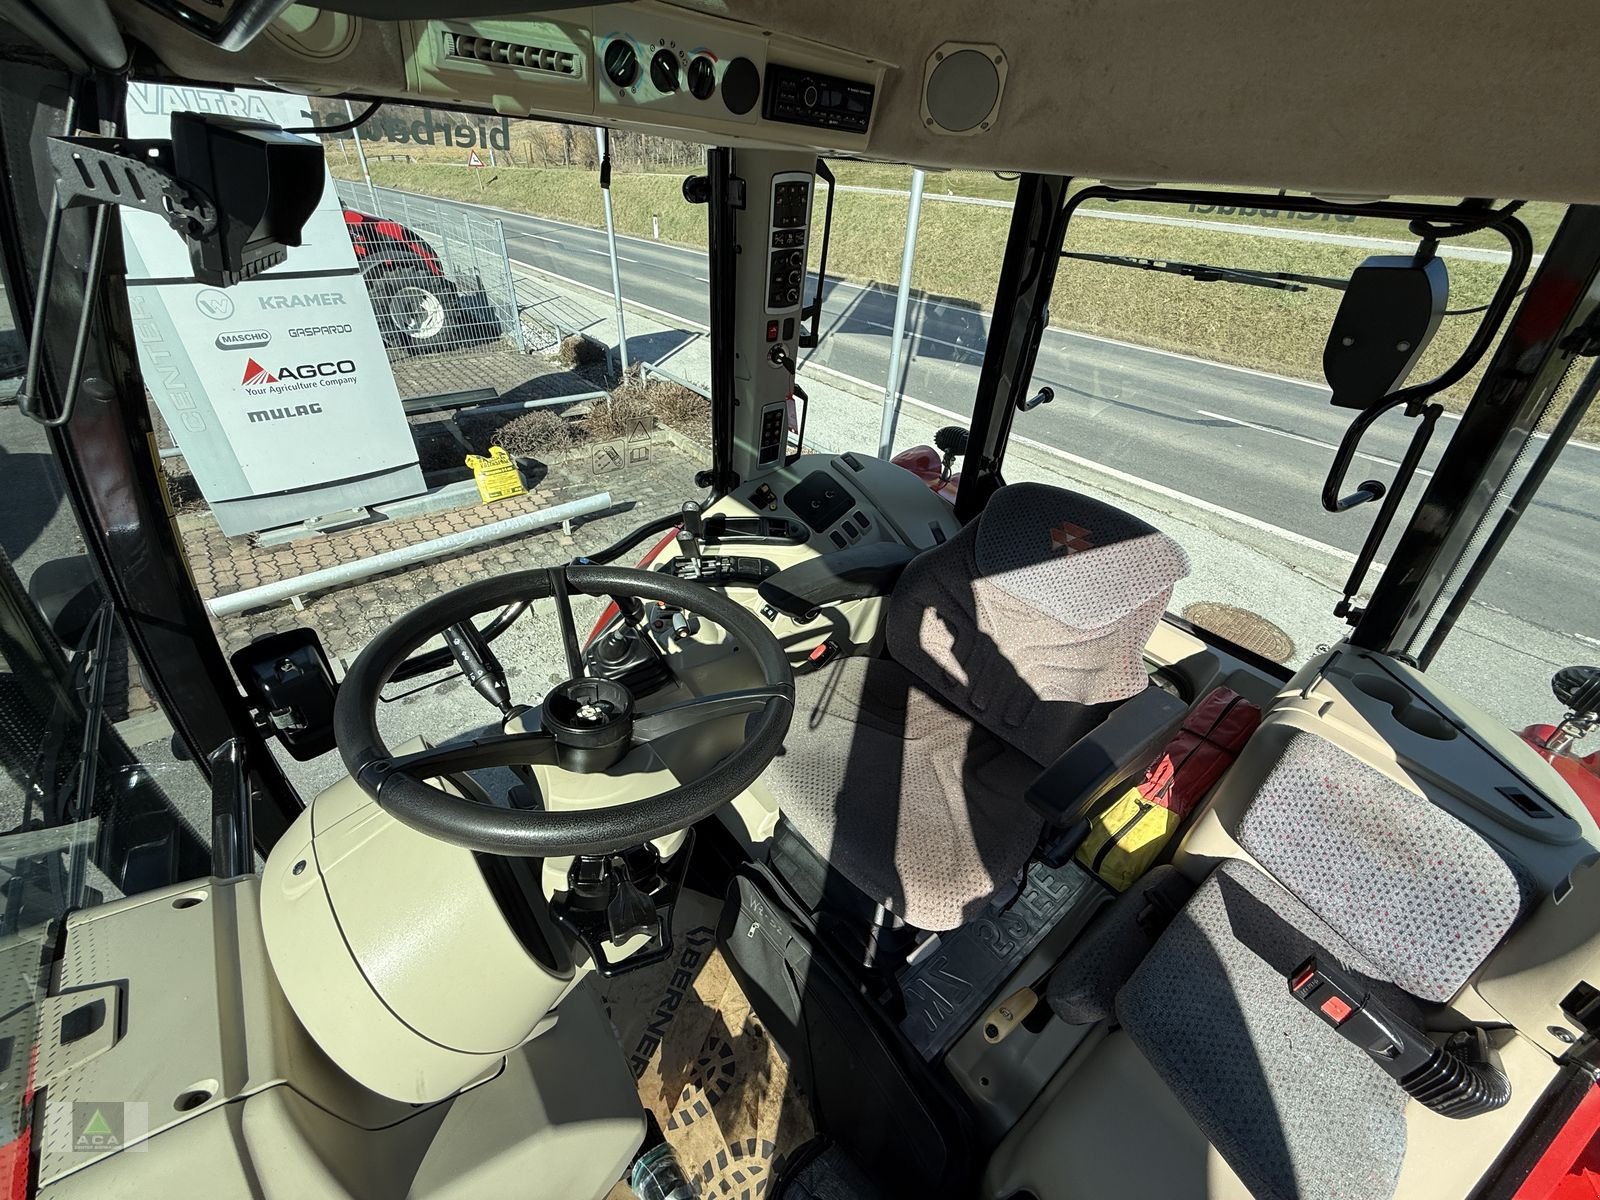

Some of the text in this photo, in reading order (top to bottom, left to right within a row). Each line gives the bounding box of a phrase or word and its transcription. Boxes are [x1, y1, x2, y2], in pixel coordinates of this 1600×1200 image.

[127, 82, 275, 124] VALTRA
[258, 292, 347, 310] KRAMER
[221, 332, 270, 344] MASCHIO
[288, 324, 353, 338] GASPARDO
[131, 295, 207, 433] CENTER
[278, 360, 357, 381] AGCO
[245, 375, 358, 396] Your Agriculture Company
[247, 402, 323, 423] MULAG
[631, 947, 701, 1081] BERNER
